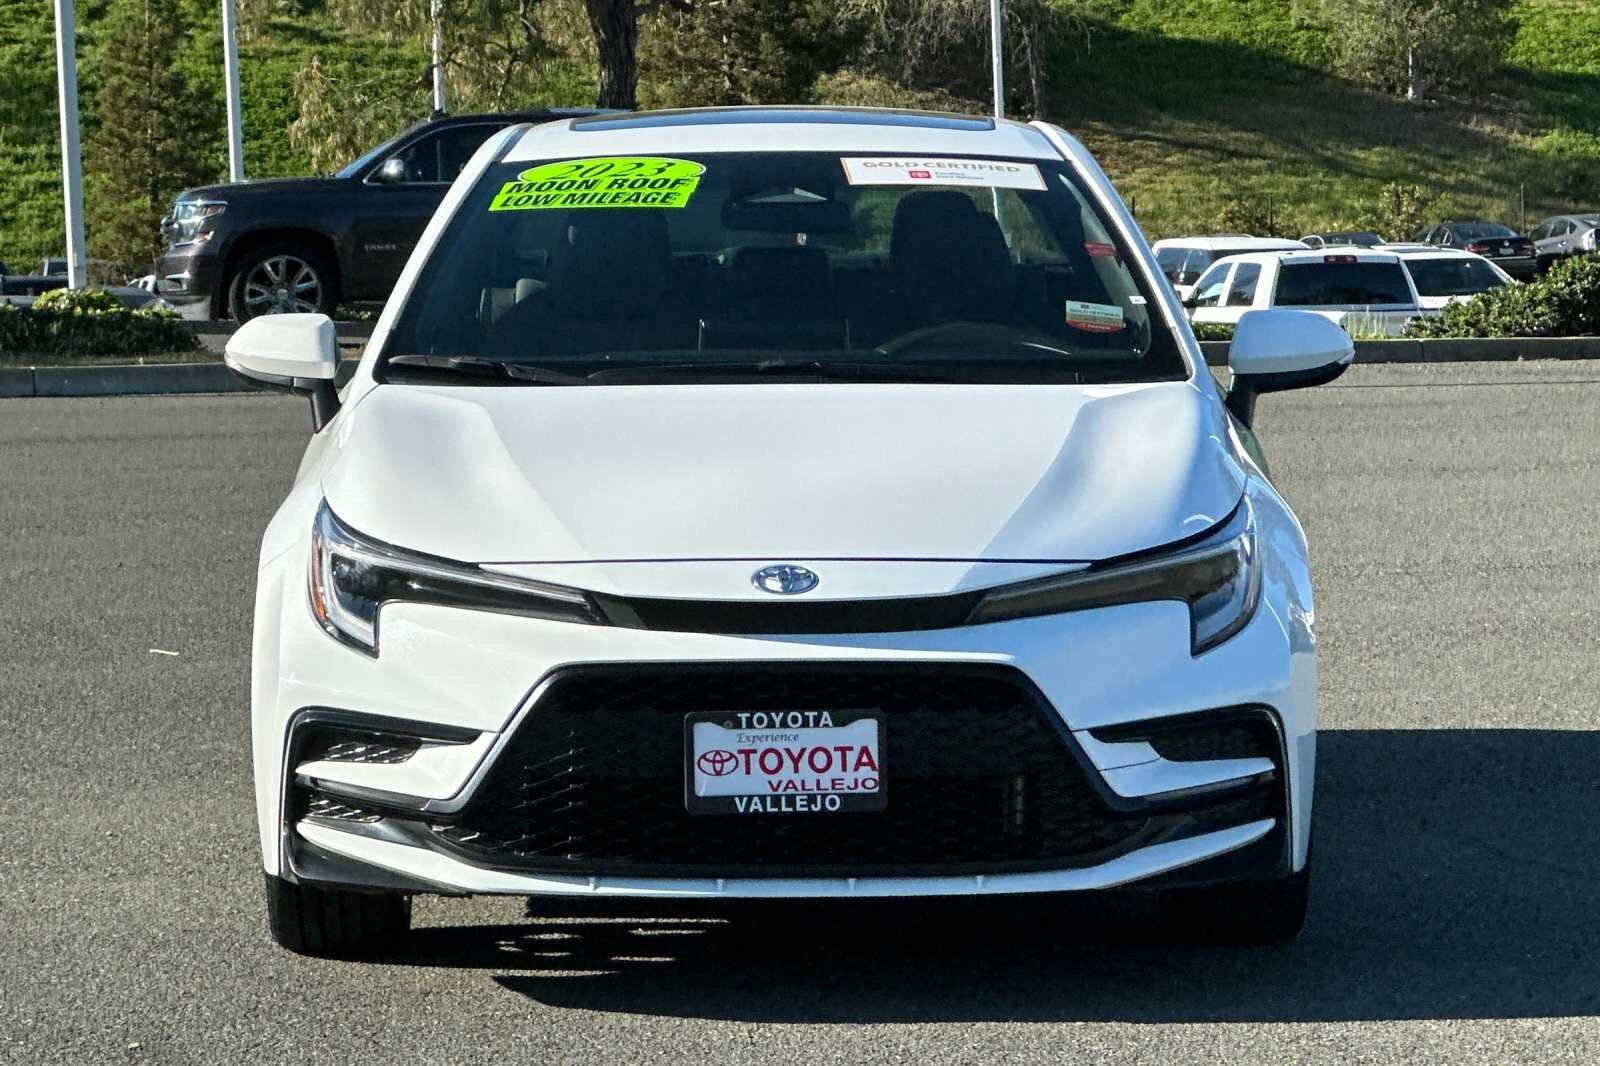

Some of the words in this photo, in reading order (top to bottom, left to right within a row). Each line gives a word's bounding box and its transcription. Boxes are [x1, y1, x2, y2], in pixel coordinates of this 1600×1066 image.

[550, 162, 676, 180] 2023
[863, 160, 918, 169] GOLD
[922, 161, 1020, 173] CERTIFIED
[506, 180, 595, 195] MOON
[606, 177, 690, 190] ROOF
[501, 194, 558, 207] LOW
[559, 192, 680, 205] MILEAGE
[737, 711, 834, 729] TOYOTA
[736, 732, 800, 745] Experience
[737, 745, 878, 776] TOYOTA
[767, 777, 880, 793] VALLEJO
[734, 795, 841, 813] VALLEJO
